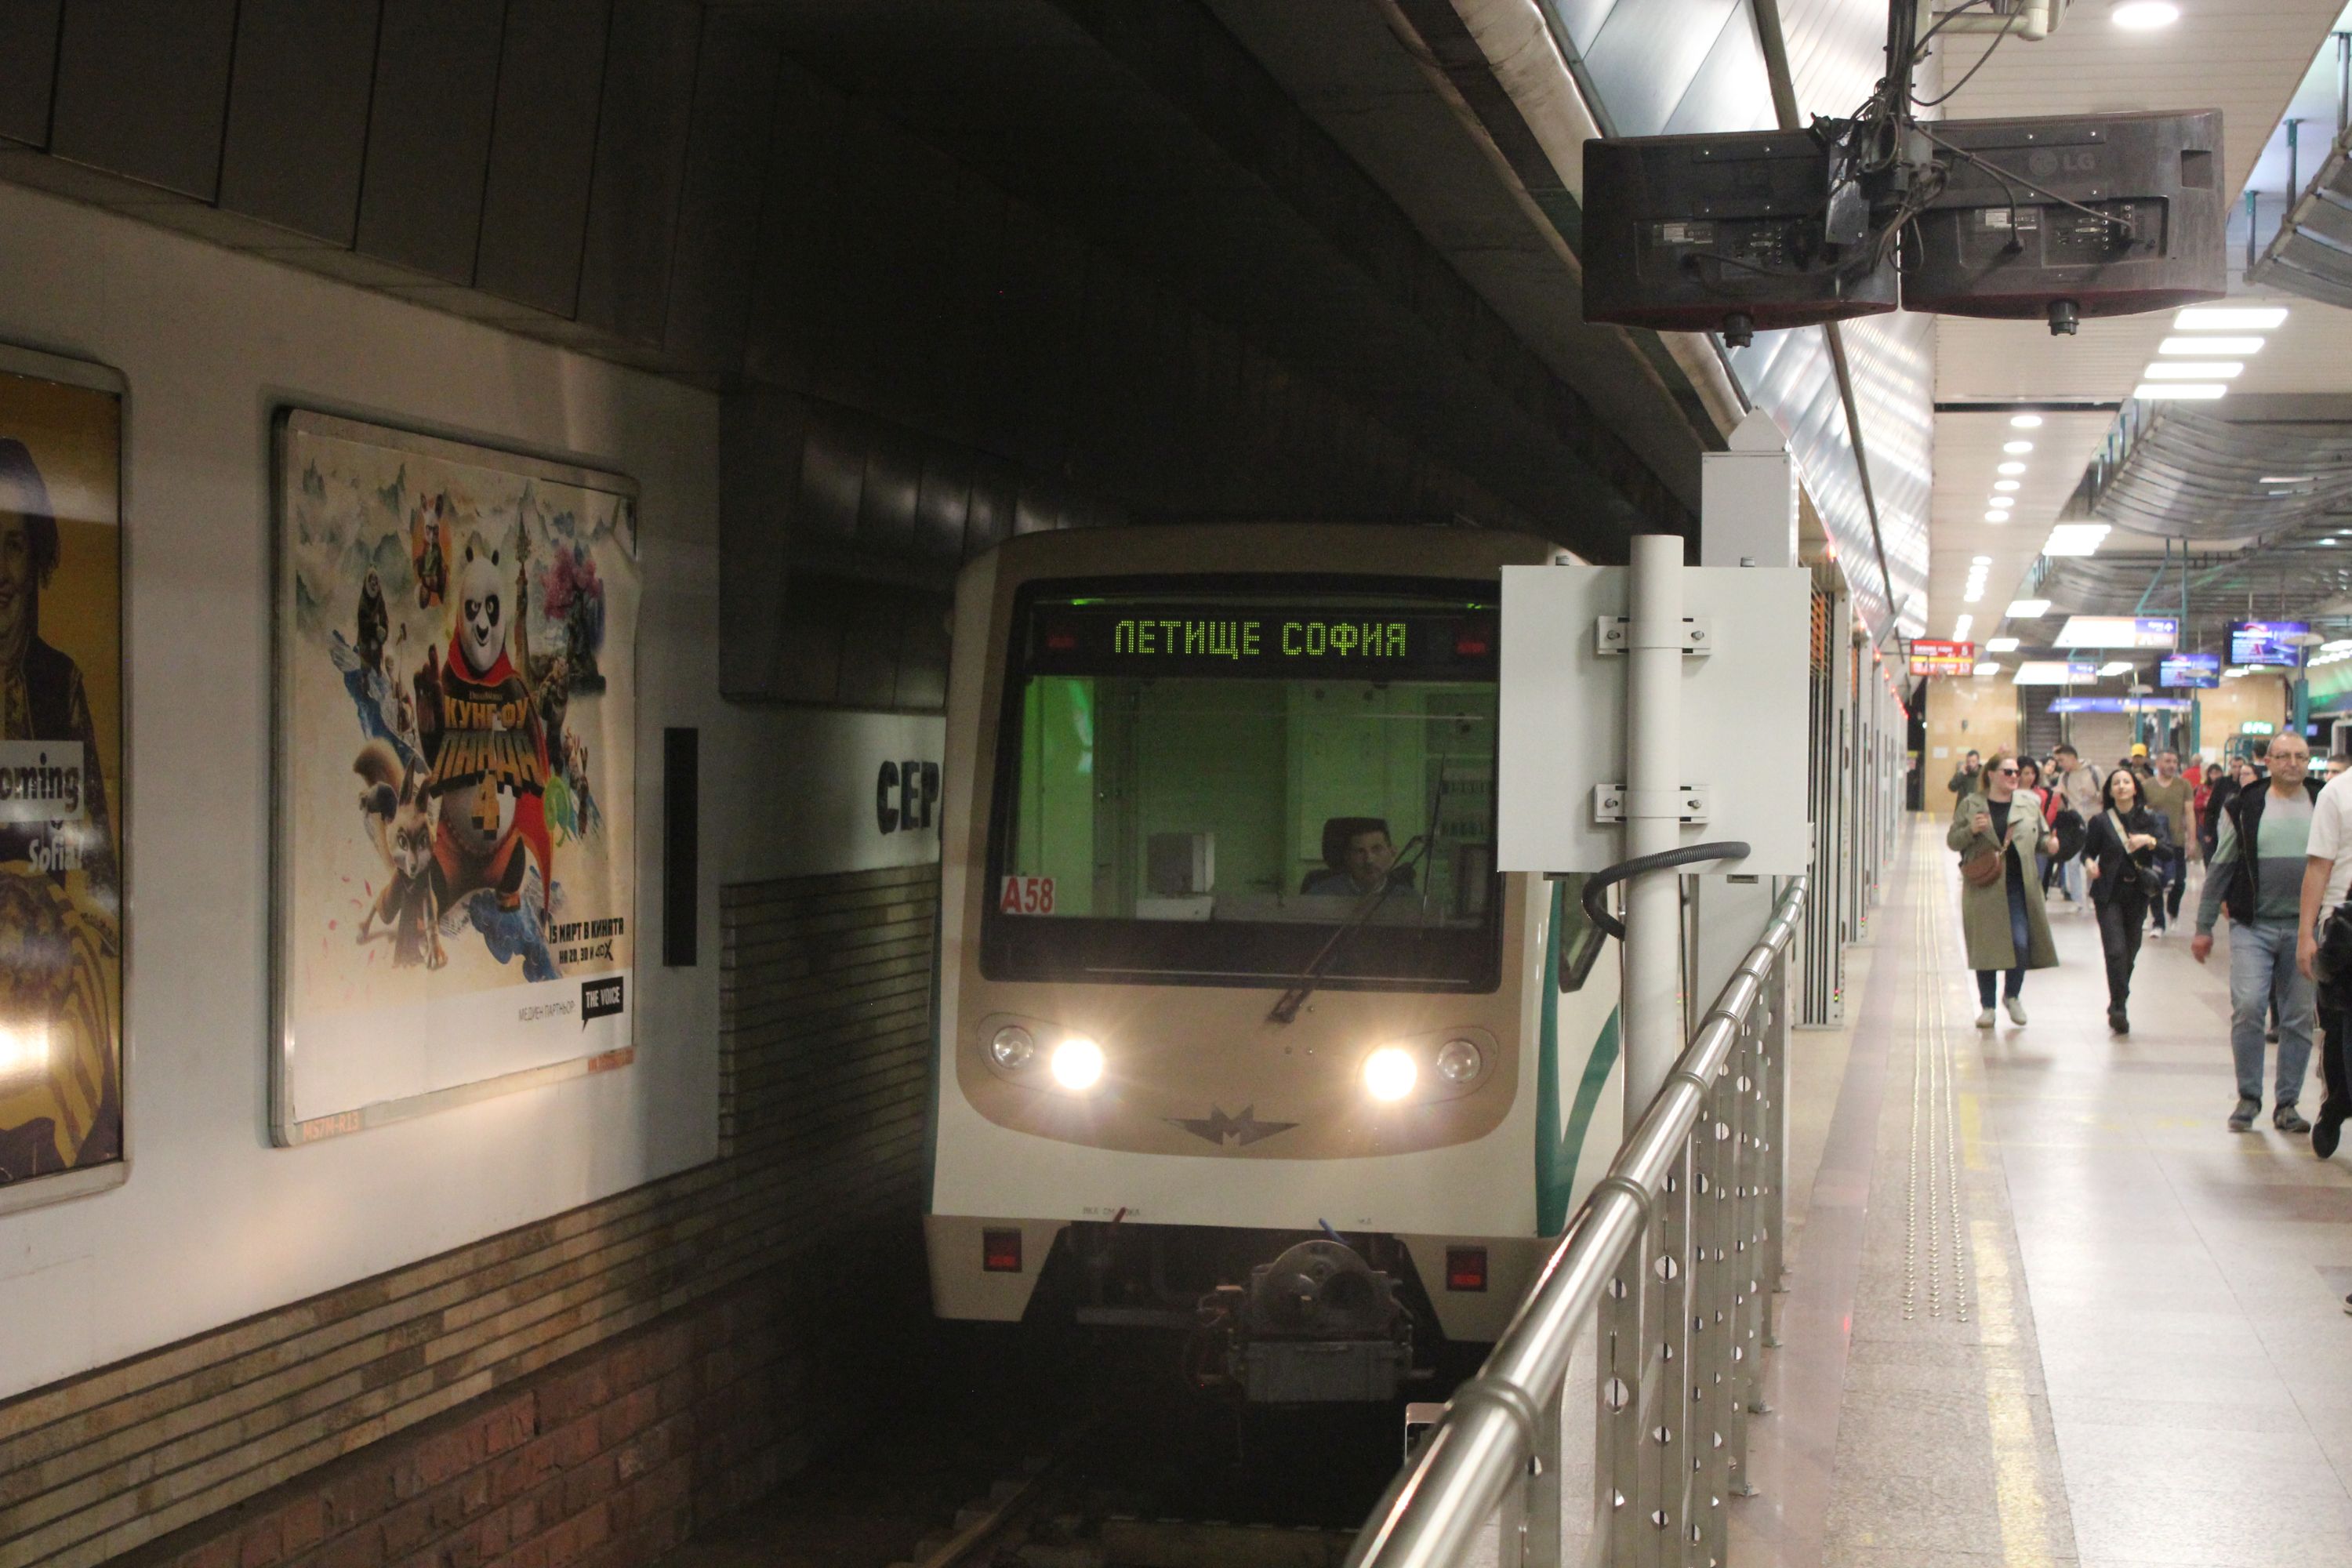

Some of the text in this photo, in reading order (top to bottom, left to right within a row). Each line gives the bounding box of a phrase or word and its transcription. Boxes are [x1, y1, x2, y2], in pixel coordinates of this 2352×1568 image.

[1116, 621, 1406, 660] ЛЕТИЩЕ СОФИЯ
[430, 732, 543, 788] ПАНДА
[877, 760, 939, 835] СЕР
[1001, 876, 1054, 913] A58
[559, 923, 582, 943] МАРТ
[591, 917, 624, 938] КИНАТА
[586, 986, 620, 1008] THE VOICE
